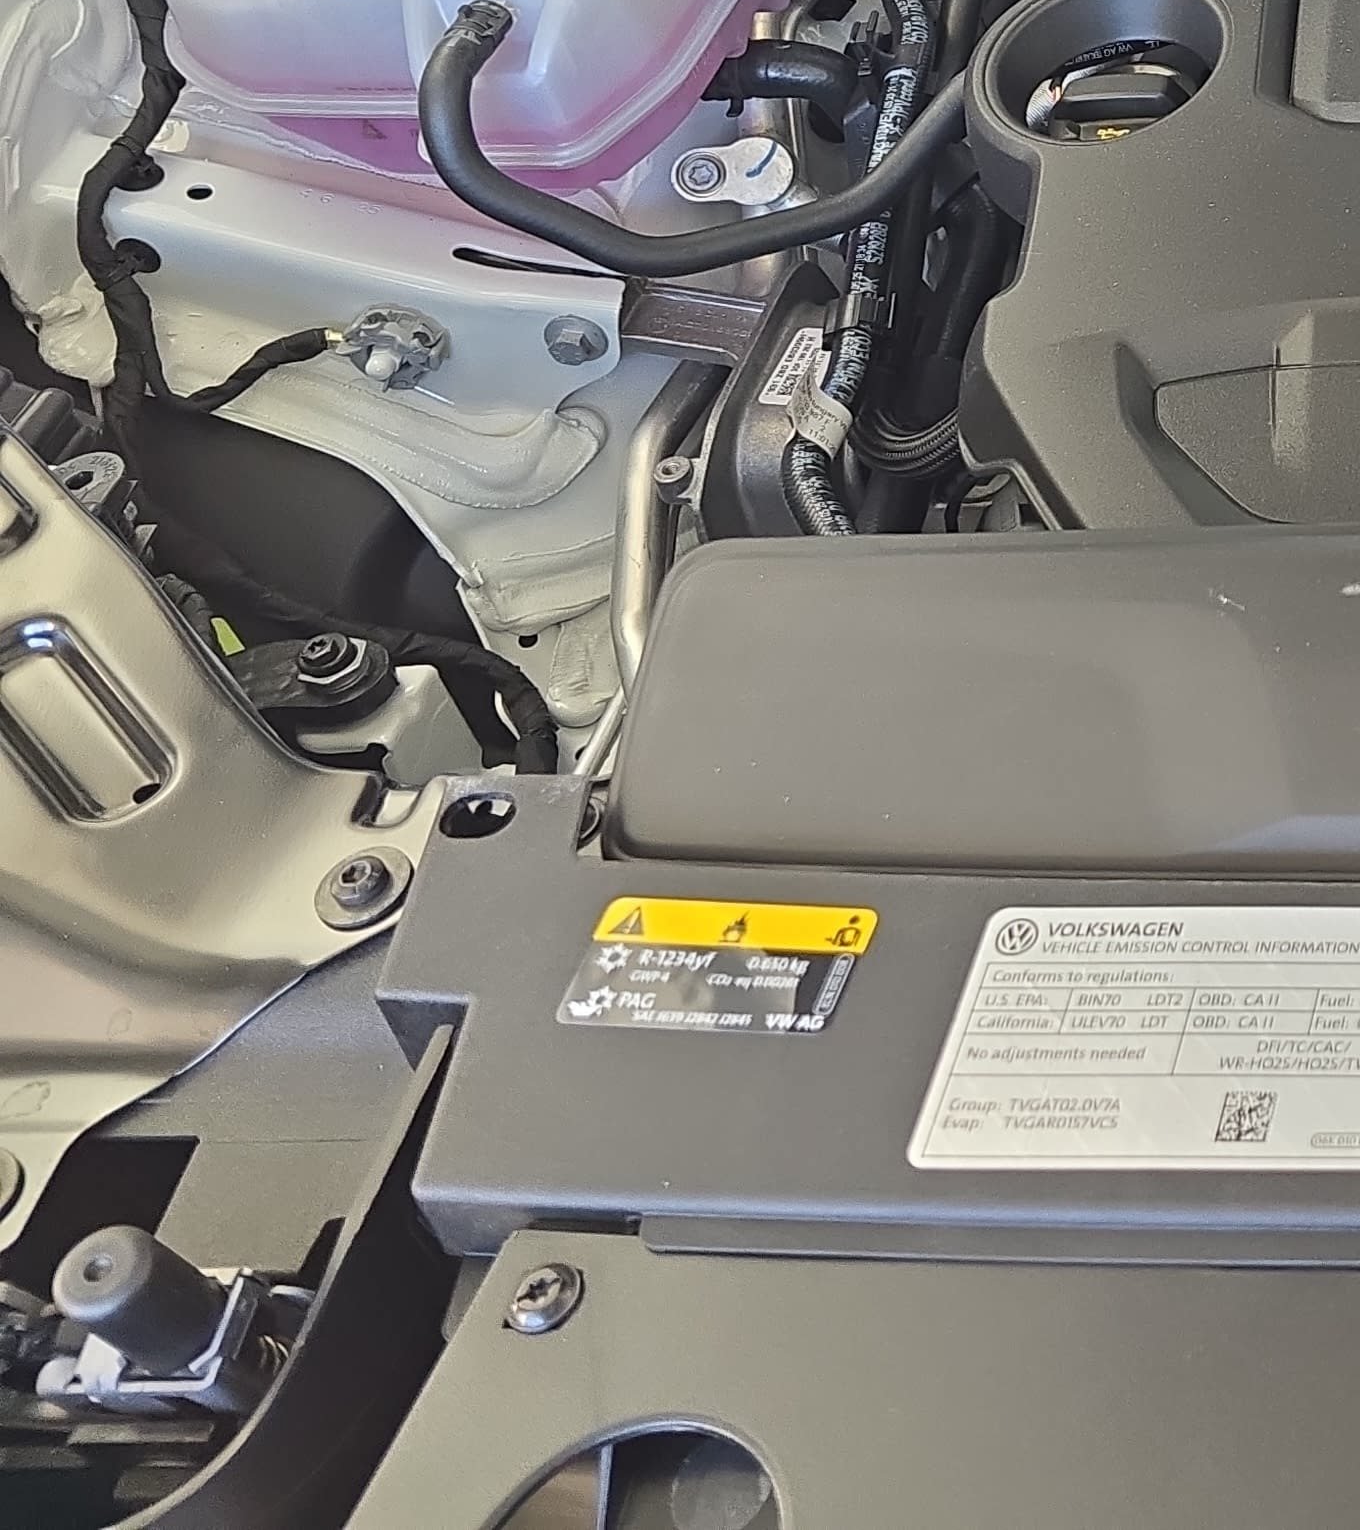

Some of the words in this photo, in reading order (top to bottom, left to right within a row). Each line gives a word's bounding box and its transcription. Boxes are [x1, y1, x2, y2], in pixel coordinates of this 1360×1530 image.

[1049, 922, 1184, 937] VOLKSWAGEN
[1042, 941, 1100, 954] VEHICLE
[1105, 941, 1177, 954] EMISSION
[1182, 941, 1250, 954] CONTROL
[1255, 941, 1360, 954] INFORMATION
[639, 949, 718, 970] R-1234yf
[992, 969, 1063, 983] Conforms
[1066, 971, 1083, 983] to
[1087, 969, 1175, 986] regulations:
[617, 991, 657, 1010] PAG
[1077, 993, 1122, 1007] BIN70
[1147, 993, 1184, 1007] LDT2
[1243, 993, 1267, 1007] CA
[765, 1013, 797, 1031] VW
[796, 1014, 826, 1031] AG
[1071, 1015, 1126, 1029] ULEV70
[1140, 1015, 1169, 1029] LDT
[1237, 1016, 1261, 1029] CA
[966, 1047, 989, 1060] No
[990, 1046, 1087, 1063] adjustments
[1089, 1046, 1147, 1060] needed
[1256, 1039, 1353, 1054] DFI/TC/CAC/
